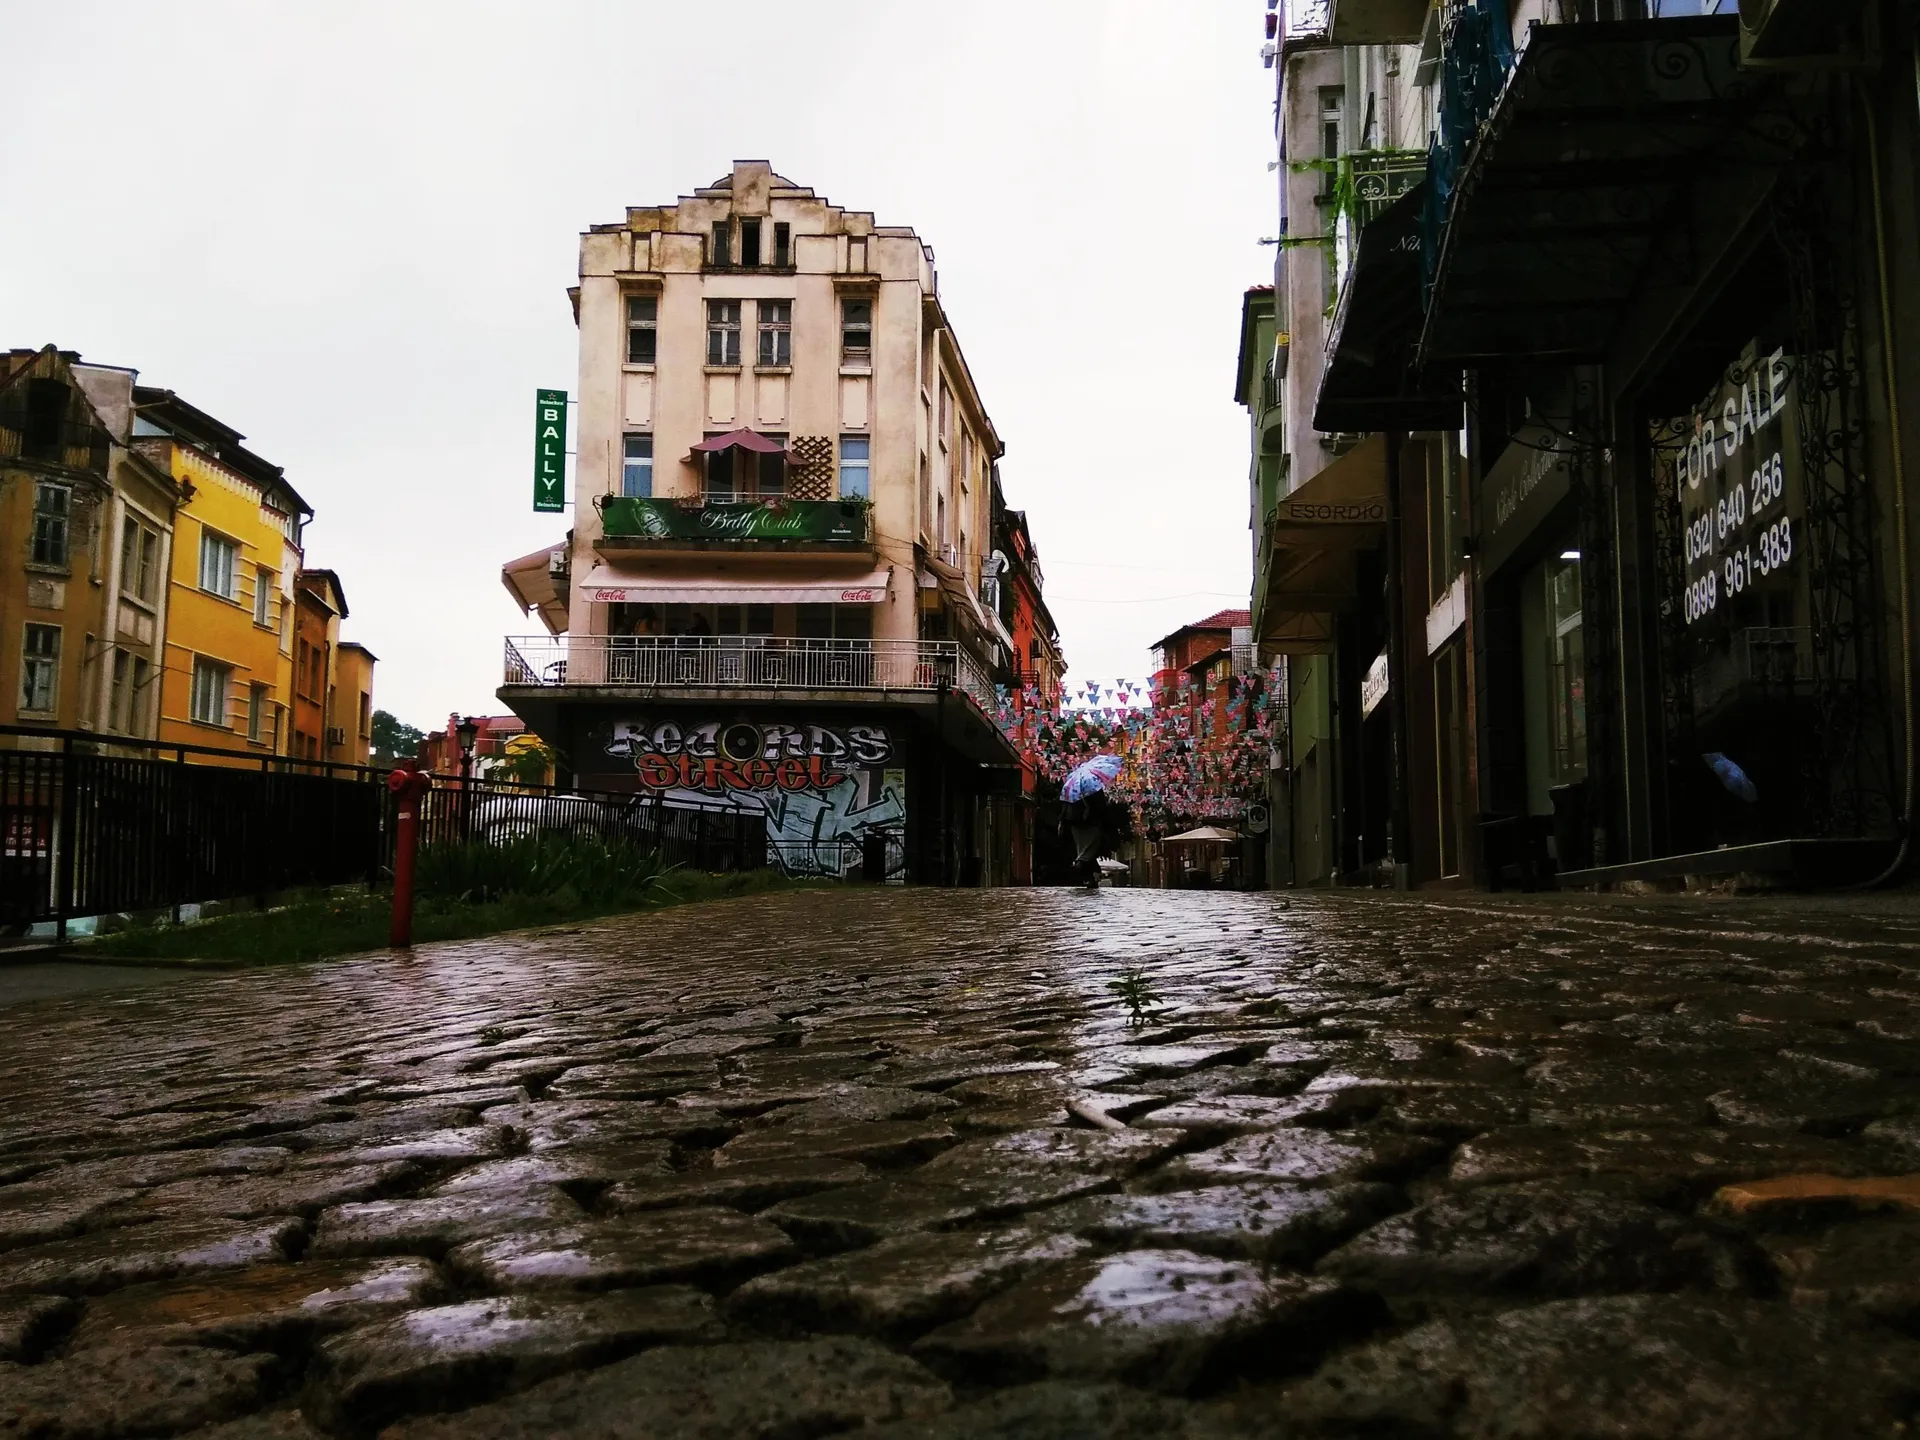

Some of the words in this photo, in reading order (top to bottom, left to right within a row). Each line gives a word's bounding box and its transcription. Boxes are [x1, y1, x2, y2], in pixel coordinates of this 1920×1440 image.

[542, 408, 559, 491] BALLY
[1676, 419, 1717, 502] FOR
[1723, 345, 1786, 457] SALE
[700, 508, 758, 537] Bally
[1290, 504, 1383, 520] ESORDIO
[1717, 483, 1745, 540] 640
[1751, 452, 1783, 516] 256
[1684, 570, 1716, 625] 0899
[1725, 516, 1792, 598] 961-383
